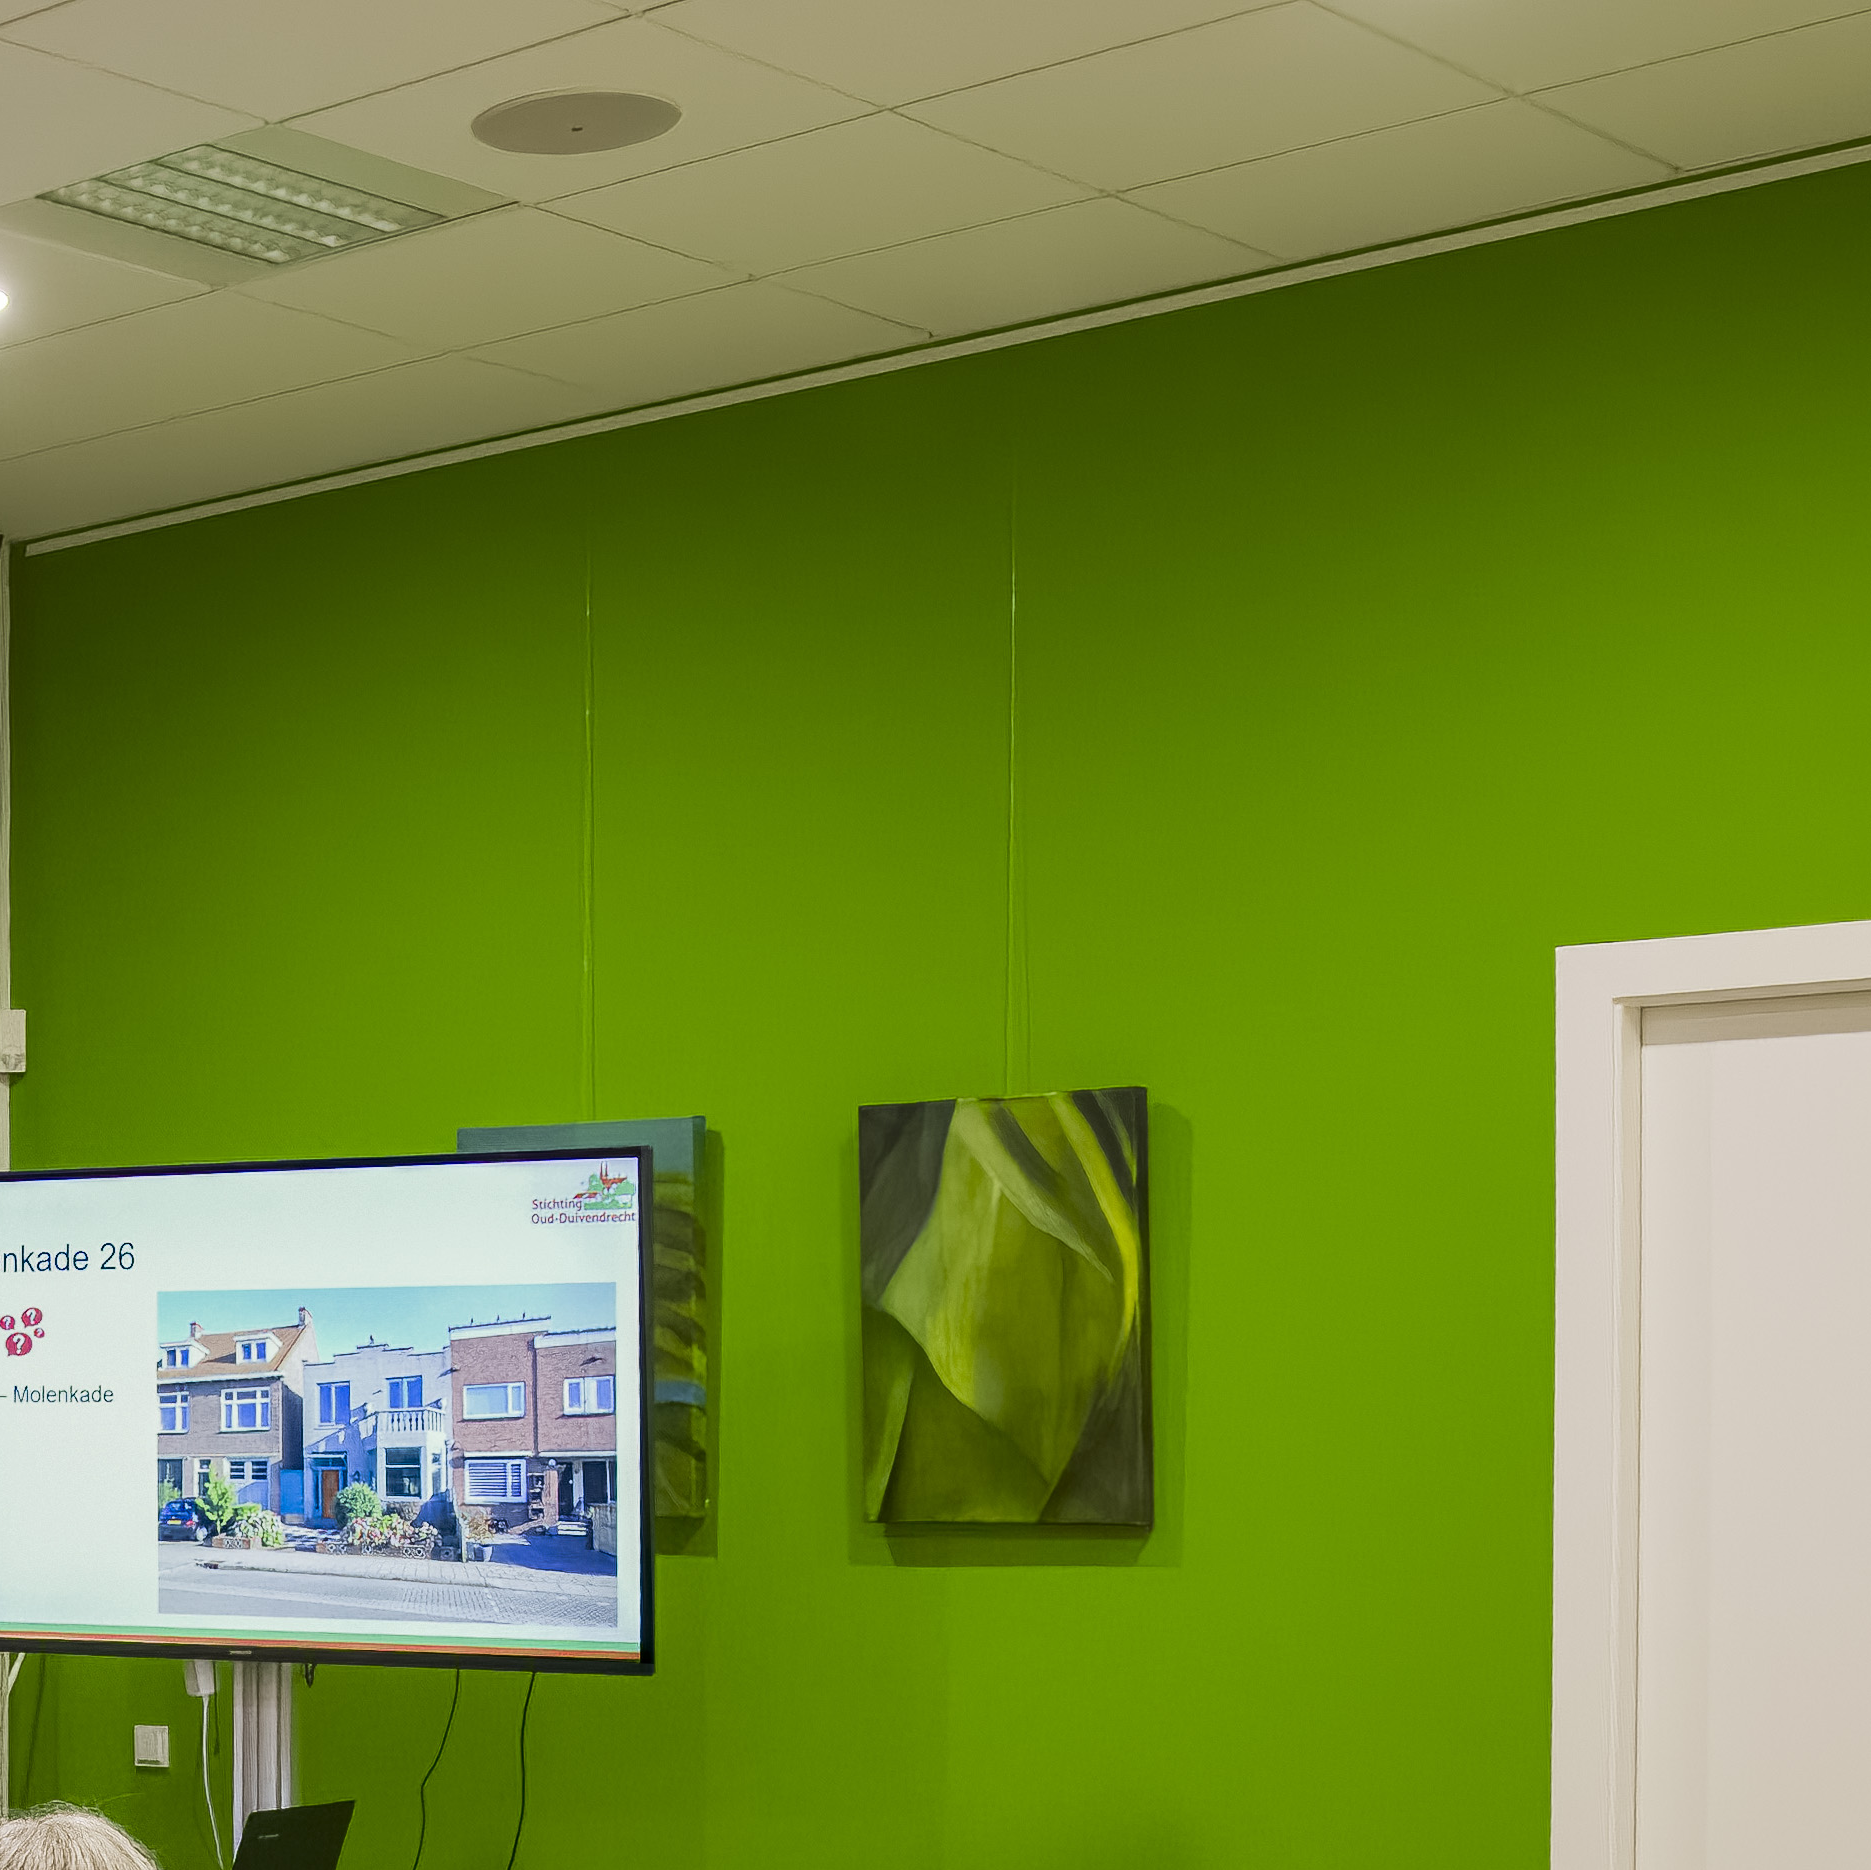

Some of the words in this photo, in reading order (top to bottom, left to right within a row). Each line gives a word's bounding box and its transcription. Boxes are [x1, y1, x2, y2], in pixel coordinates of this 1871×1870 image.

[532, 1198, 583, 1211] Stichting
[100, 1242, 135, 1270] 26
[13, 1385, 115, 1403] Molenkade
